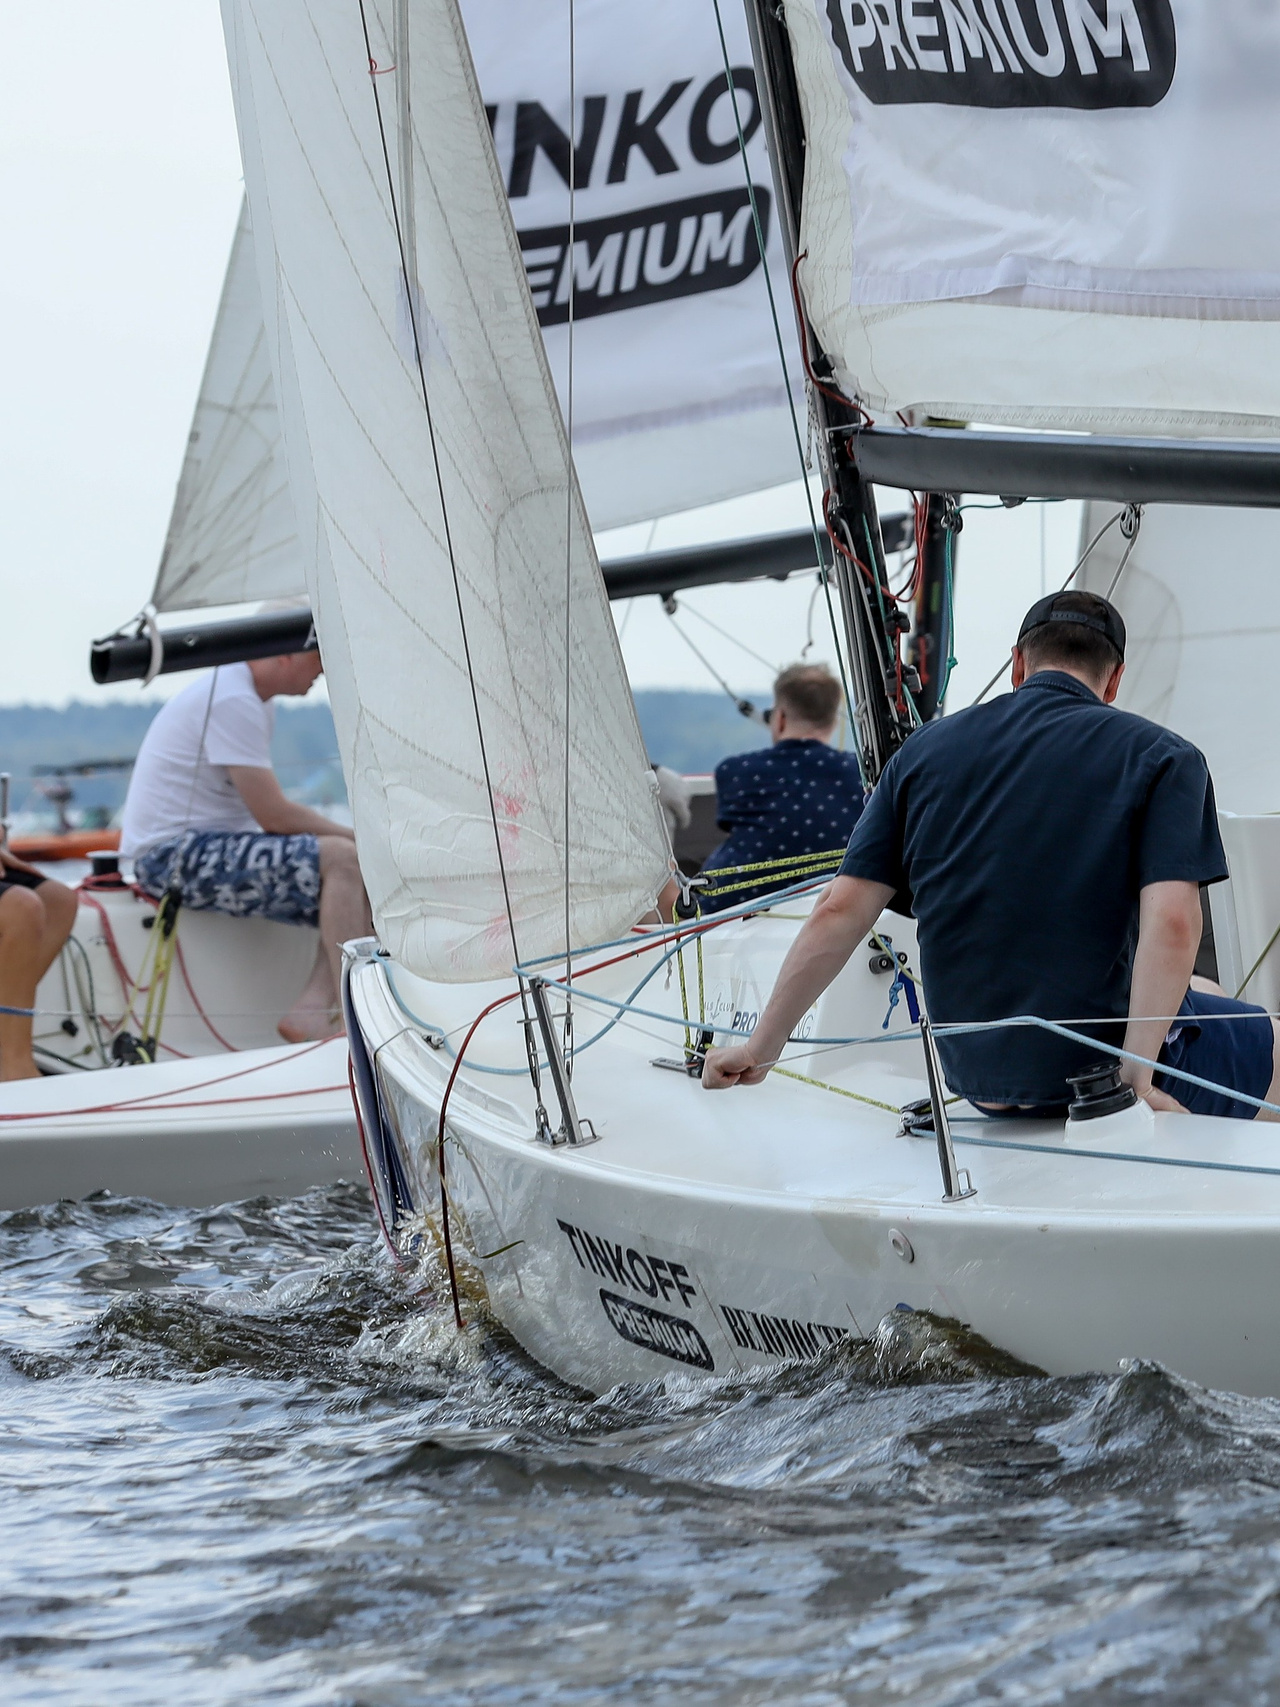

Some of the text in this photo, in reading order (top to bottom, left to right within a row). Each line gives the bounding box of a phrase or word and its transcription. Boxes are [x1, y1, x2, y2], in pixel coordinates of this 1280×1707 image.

[840, 0, 1151, 78] PREMIUM
[556, 1218, 697, 1309] TINKOFF
[605, 1298, 708, 1362] PREMIUM
